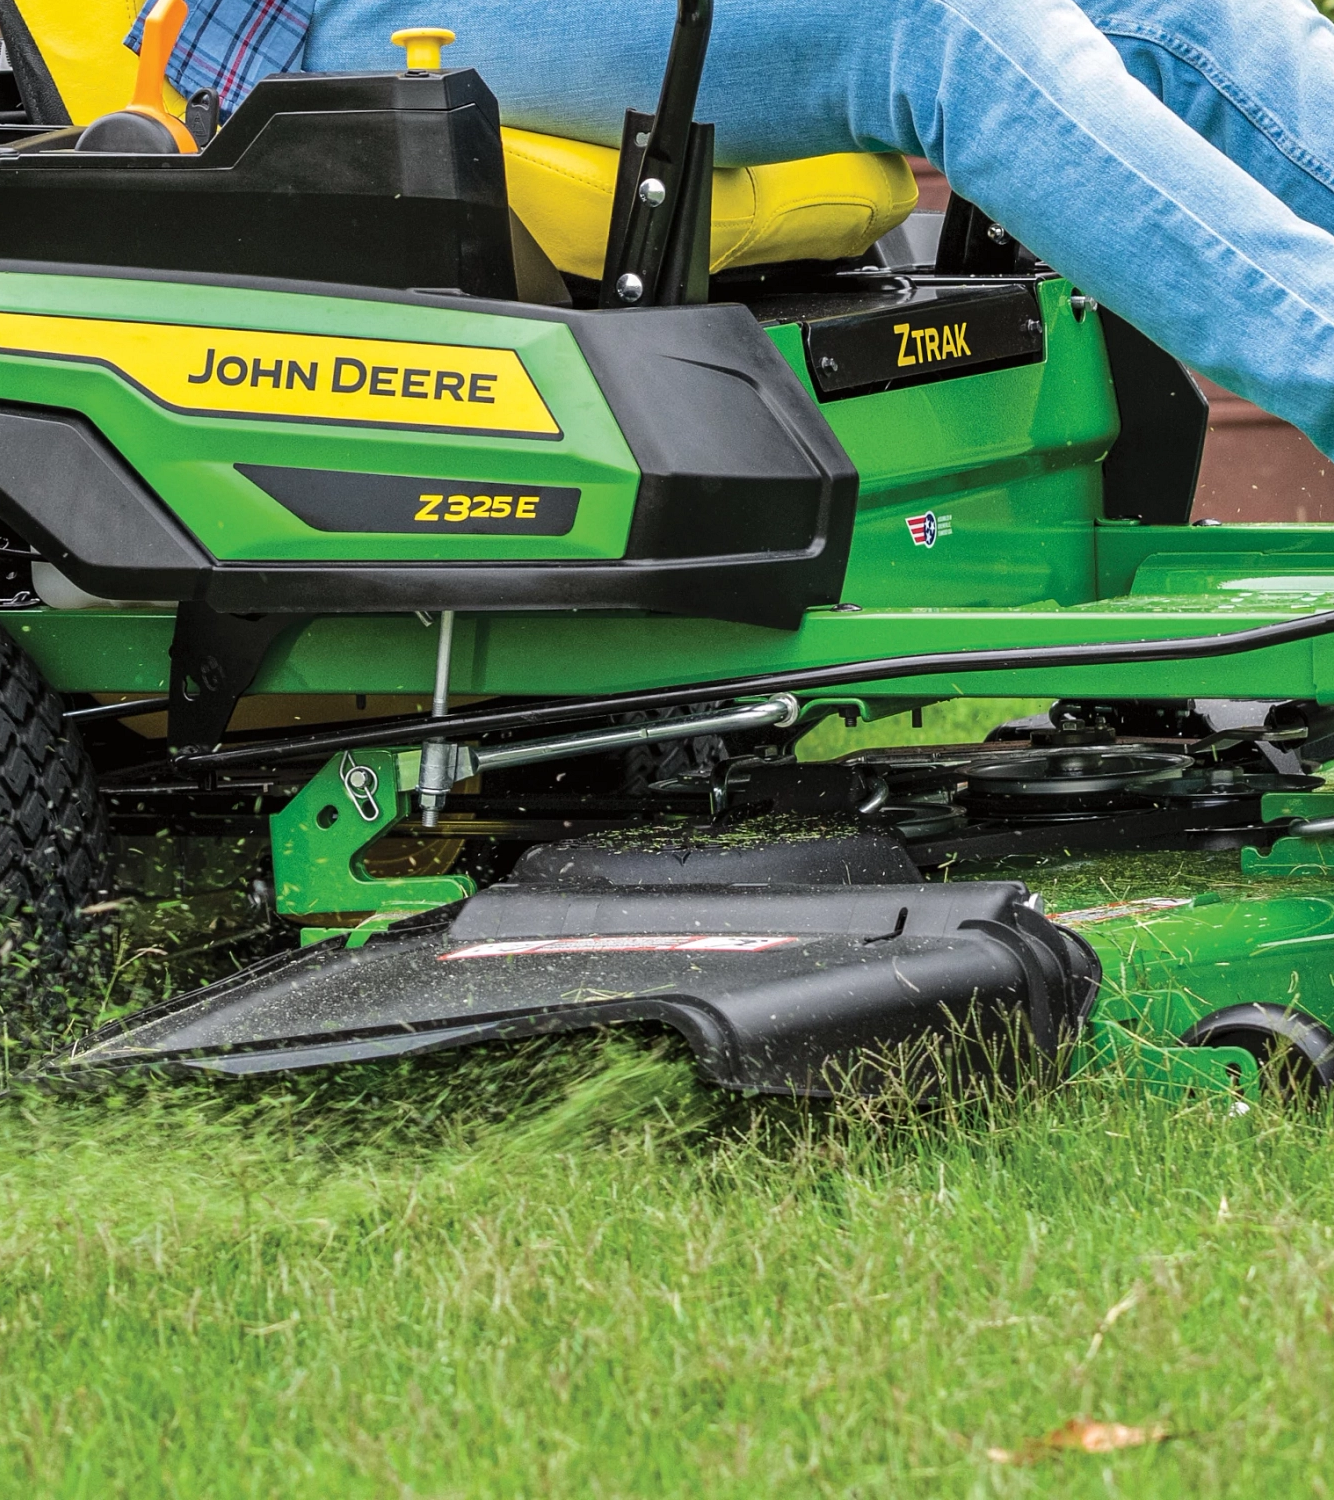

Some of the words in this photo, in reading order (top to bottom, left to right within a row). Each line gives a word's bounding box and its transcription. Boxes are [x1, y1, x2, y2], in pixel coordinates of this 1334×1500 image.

[893, 322, 972, 367] ZTRAK
[188, 348, 318, 391] JOHN
[332, 357, 498, 404] DEERE
